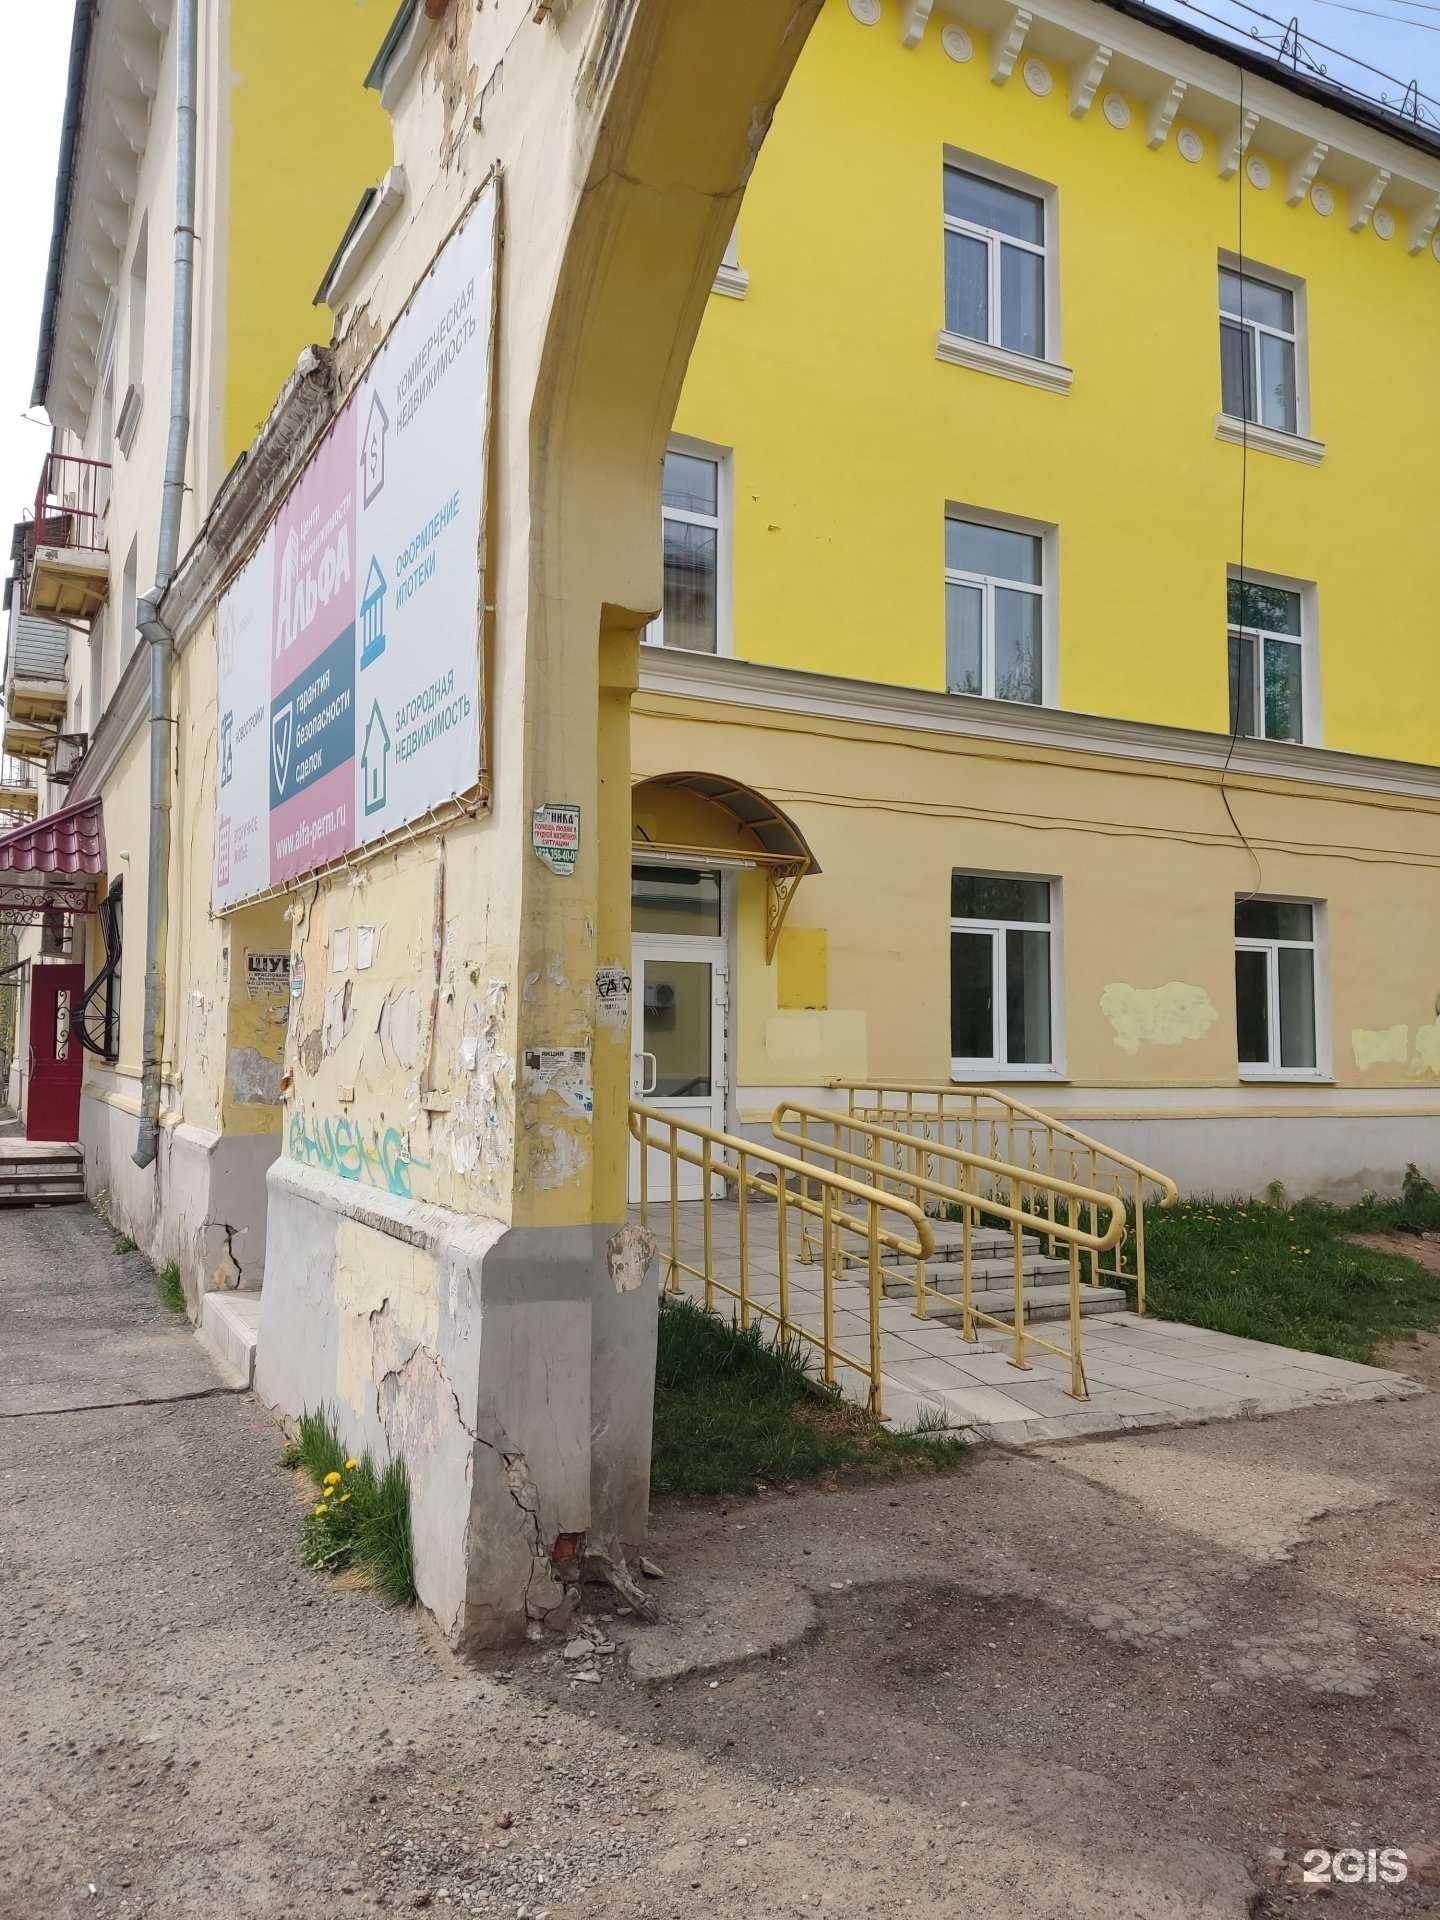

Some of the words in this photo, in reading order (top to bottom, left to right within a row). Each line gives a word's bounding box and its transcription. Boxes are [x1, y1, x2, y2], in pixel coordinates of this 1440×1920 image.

[396, 277, 474, 404] КОММЕРЧЕСКАЯ
[396, 315, 476, 436] НЕДВИЖИМОСТЬ
[396, 489, 460, 577] ОФОРМЛЕНИЕ
[395, 550, 436, 609] ИПОТЕКИ
[295, 688, 351, 749] безопасности
[296, 668, 330, 715] гарантия
[395, 668, 454, 733] ЗАГОРОДНАЯ
[395, 693, 471, 765] НЕДВИЖИМОСТЬ
[295, 748, 323, 785] сделок
[275, 803, 346, 860] www.alfa-perm.ru
